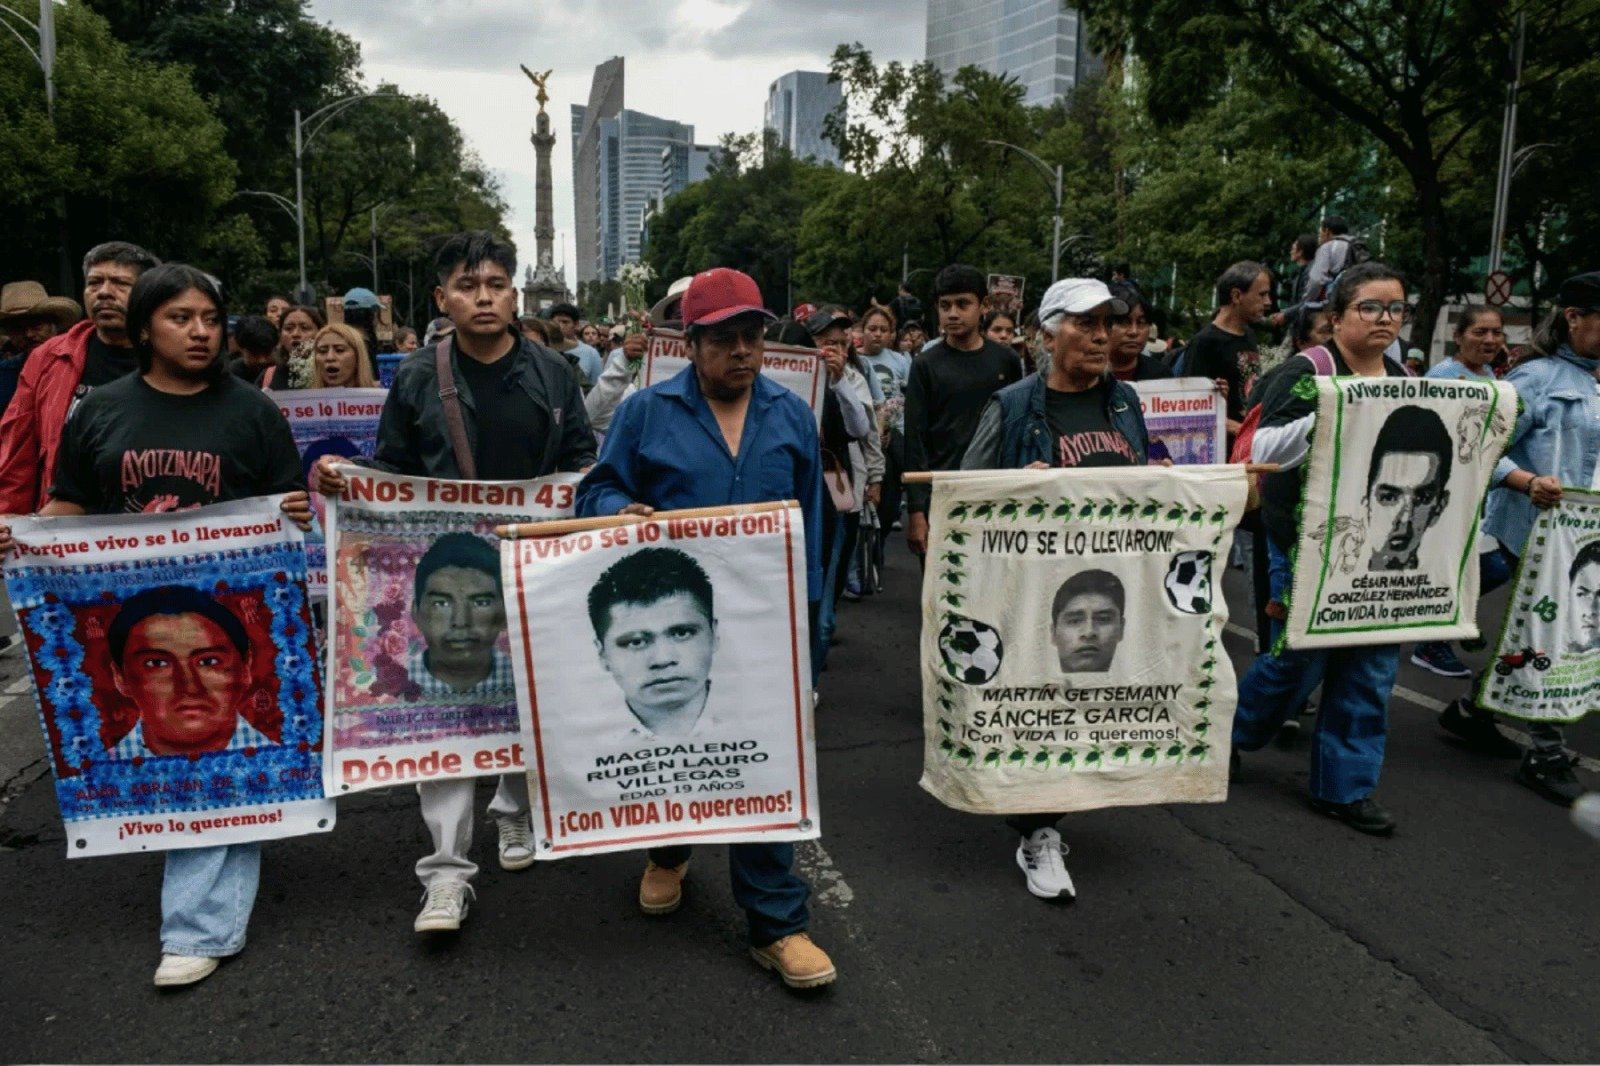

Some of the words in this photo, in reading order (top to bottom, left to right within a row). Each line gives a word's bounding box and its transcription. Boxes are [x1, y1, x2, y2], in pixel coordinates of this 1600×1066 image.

[655, 340, 688, 359] ¡Viv
[763, 355, 813, 374] varon!
[1152, 394, 1213, 414] llevaron!
[1347, 383, 1381, 404] ¡Vivo
[1383, 384, 1400, 398] se
[1401, 380, 1416, 399] lo
[1419, 380, 1489, 401] llevaron!
[295, 405, 315, 418] se
[318, 401, 334, 417] lo
[121, 449, 221, 497] AYOTZINAPA
[426, 479, 526, 507] faltan
[534, 483, 574, 509] 43
[524, 533, 594, 565] ¡Vivo
[600, 528, 629, 549] se
[636, 521, 661, 543] lo
[668, 510, 781, 540] llevaron!
[1583, 520, 1596, 530] se
[12, 540, 90, 560] ¡Porque
[95, 535, 140, 552] vivo
[145, 534, 167, 546] se
[171, 529, 190, 544] lo
[196, 519, 283, 542] llevaron!
[981, 529, 1029, 555] ¡VIVO
[1037, 530, 1057, 556] SE
[1065, 530, 1086, 556] LO
[1091, 529, 1176, 554] LLEVARON!
[1352, 574, 1388, 589] CÉSAR
[1327, 589, 1386, 605] GONZÁLEZ
[1387, 585, 1451, 601] HERNÁNDEZ
[1316, 607, 1346, 626] ¡Con
[1348, 605, 1376, 621] VIDA
[1378, 604, 1390, 619] lo
[1391, 600, 1453, 622] queremos!
[1532, 595, 1559, 623] 43
[982, 683, 1057, 702] MARTÍN
[1065, 683, 1184, 702] GETSEMANY
[1505, 685, 1540, 700] ¡Con
[973, 704, 1077, 728] SÁNCHEZ
[1084, 702, 1171, 724] GARCÍA
[1013, 729, 1057, 742] VIDA
[1064, 728, 1080, 741] lo
[1089, 726, 1180, 743] queremos!
[342, 749, 462, 785] Dónde
[474, 743, 525, 770] est
[595, 740, 759, 767] MAGDALENO
[587, 758, 675, 782] RUBÉN
[683, 752, 770, 769] LAURO
[617, 767, 741, 790] VILLEGAS
[620, 787, 667, 801] EDAD
[674, 784, 693, 794] 19
[697, 780, 746, 793] AÑOS
[118, 821, 164, 840] ¡Vivo
[169, 818, 186, 832] lo
[190, 809, 283, 833] queremos!
[559, 810, 604, 838] ¡Con
[609, 801, 661, 829] VIDA
[665, 799, 685, 823] lo
[688, 789, 793, 824] queremos!
